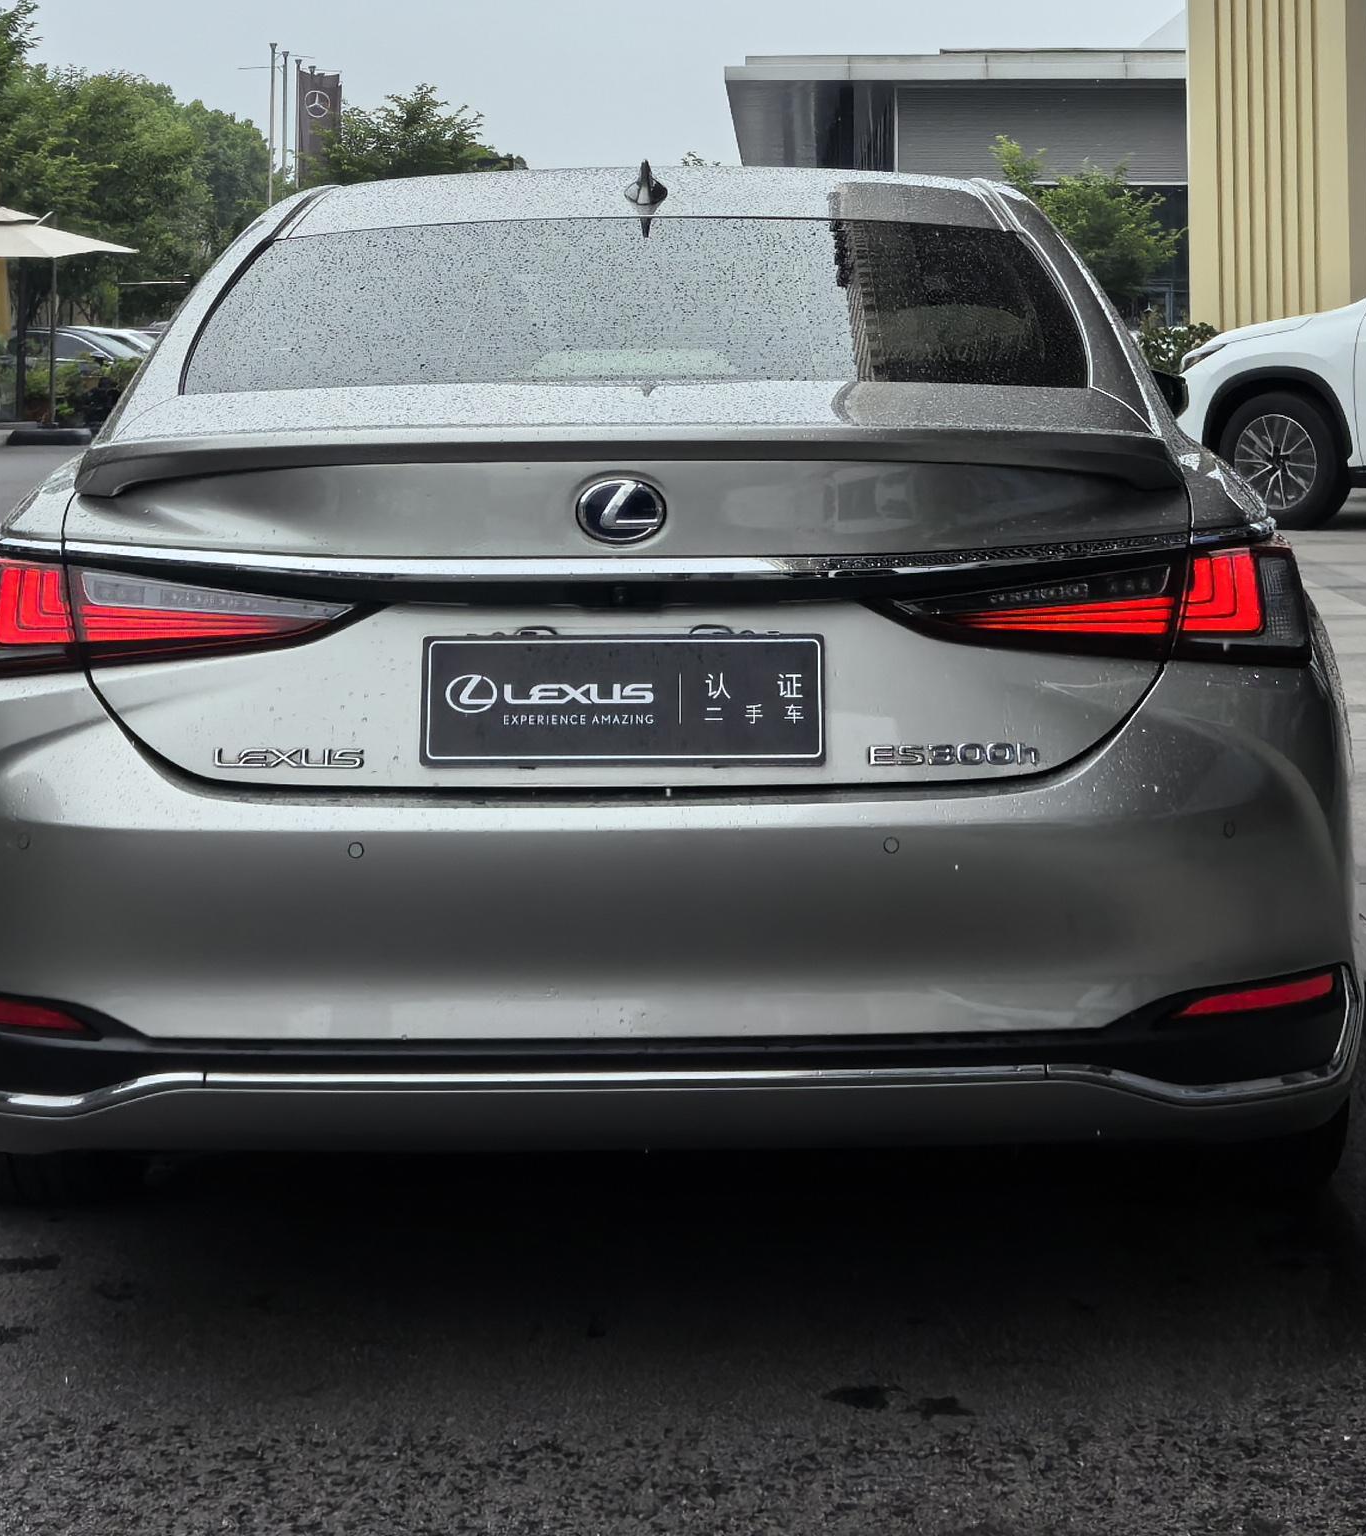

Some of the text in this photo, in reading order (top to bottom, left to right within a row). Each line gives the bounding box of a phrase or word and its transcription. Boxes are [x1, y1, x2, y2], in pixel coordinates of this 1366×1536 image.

[503, 683, 654, 704] LEXUS
[704, 672, 805, 700] 认证
[503, 714, 654, 726] EXPERIENCE AMAZING
[704, 704, 805, 725] 二手车
[213, 748, 365, 769] LEXUS
[868, 742, 1041, 766] ES300h
